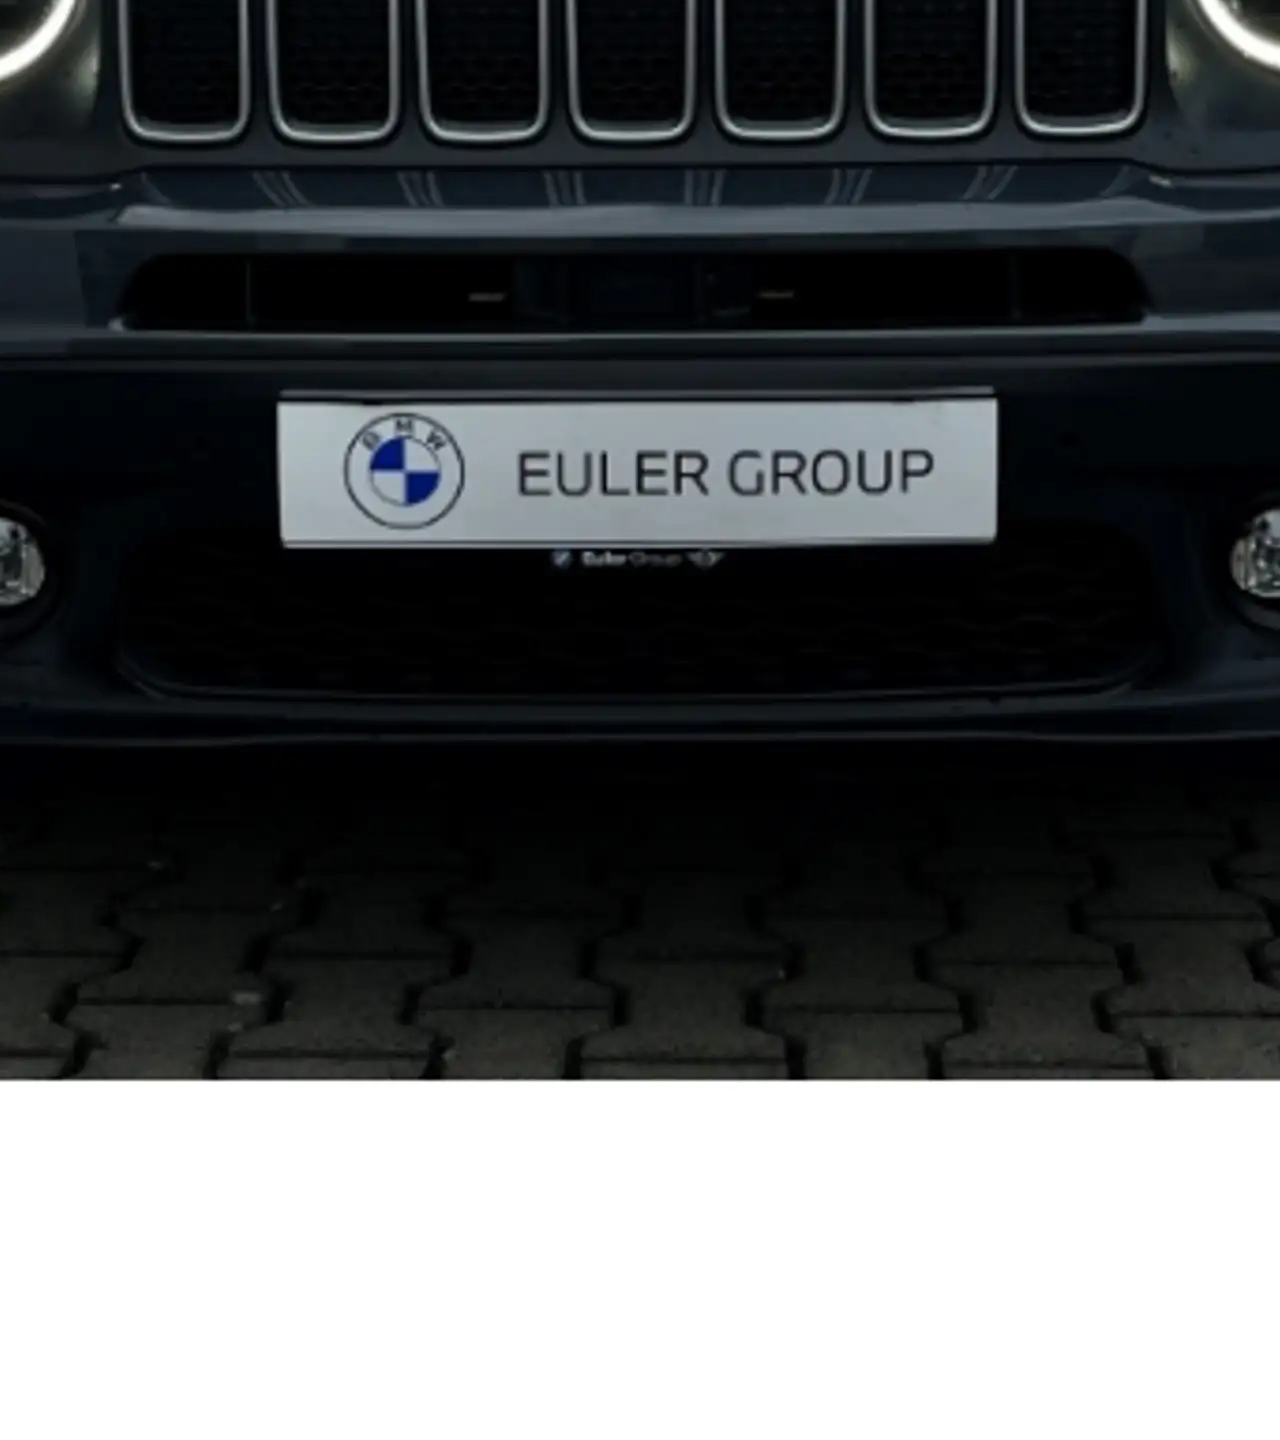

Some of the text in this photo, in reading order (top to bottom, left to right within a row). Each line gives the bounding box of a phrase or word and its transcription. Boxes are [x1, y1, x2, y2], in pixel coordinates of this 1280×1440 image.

[361, 419, 447, 452] BMW
[517, 448, 935, 497] EULER GROUP
